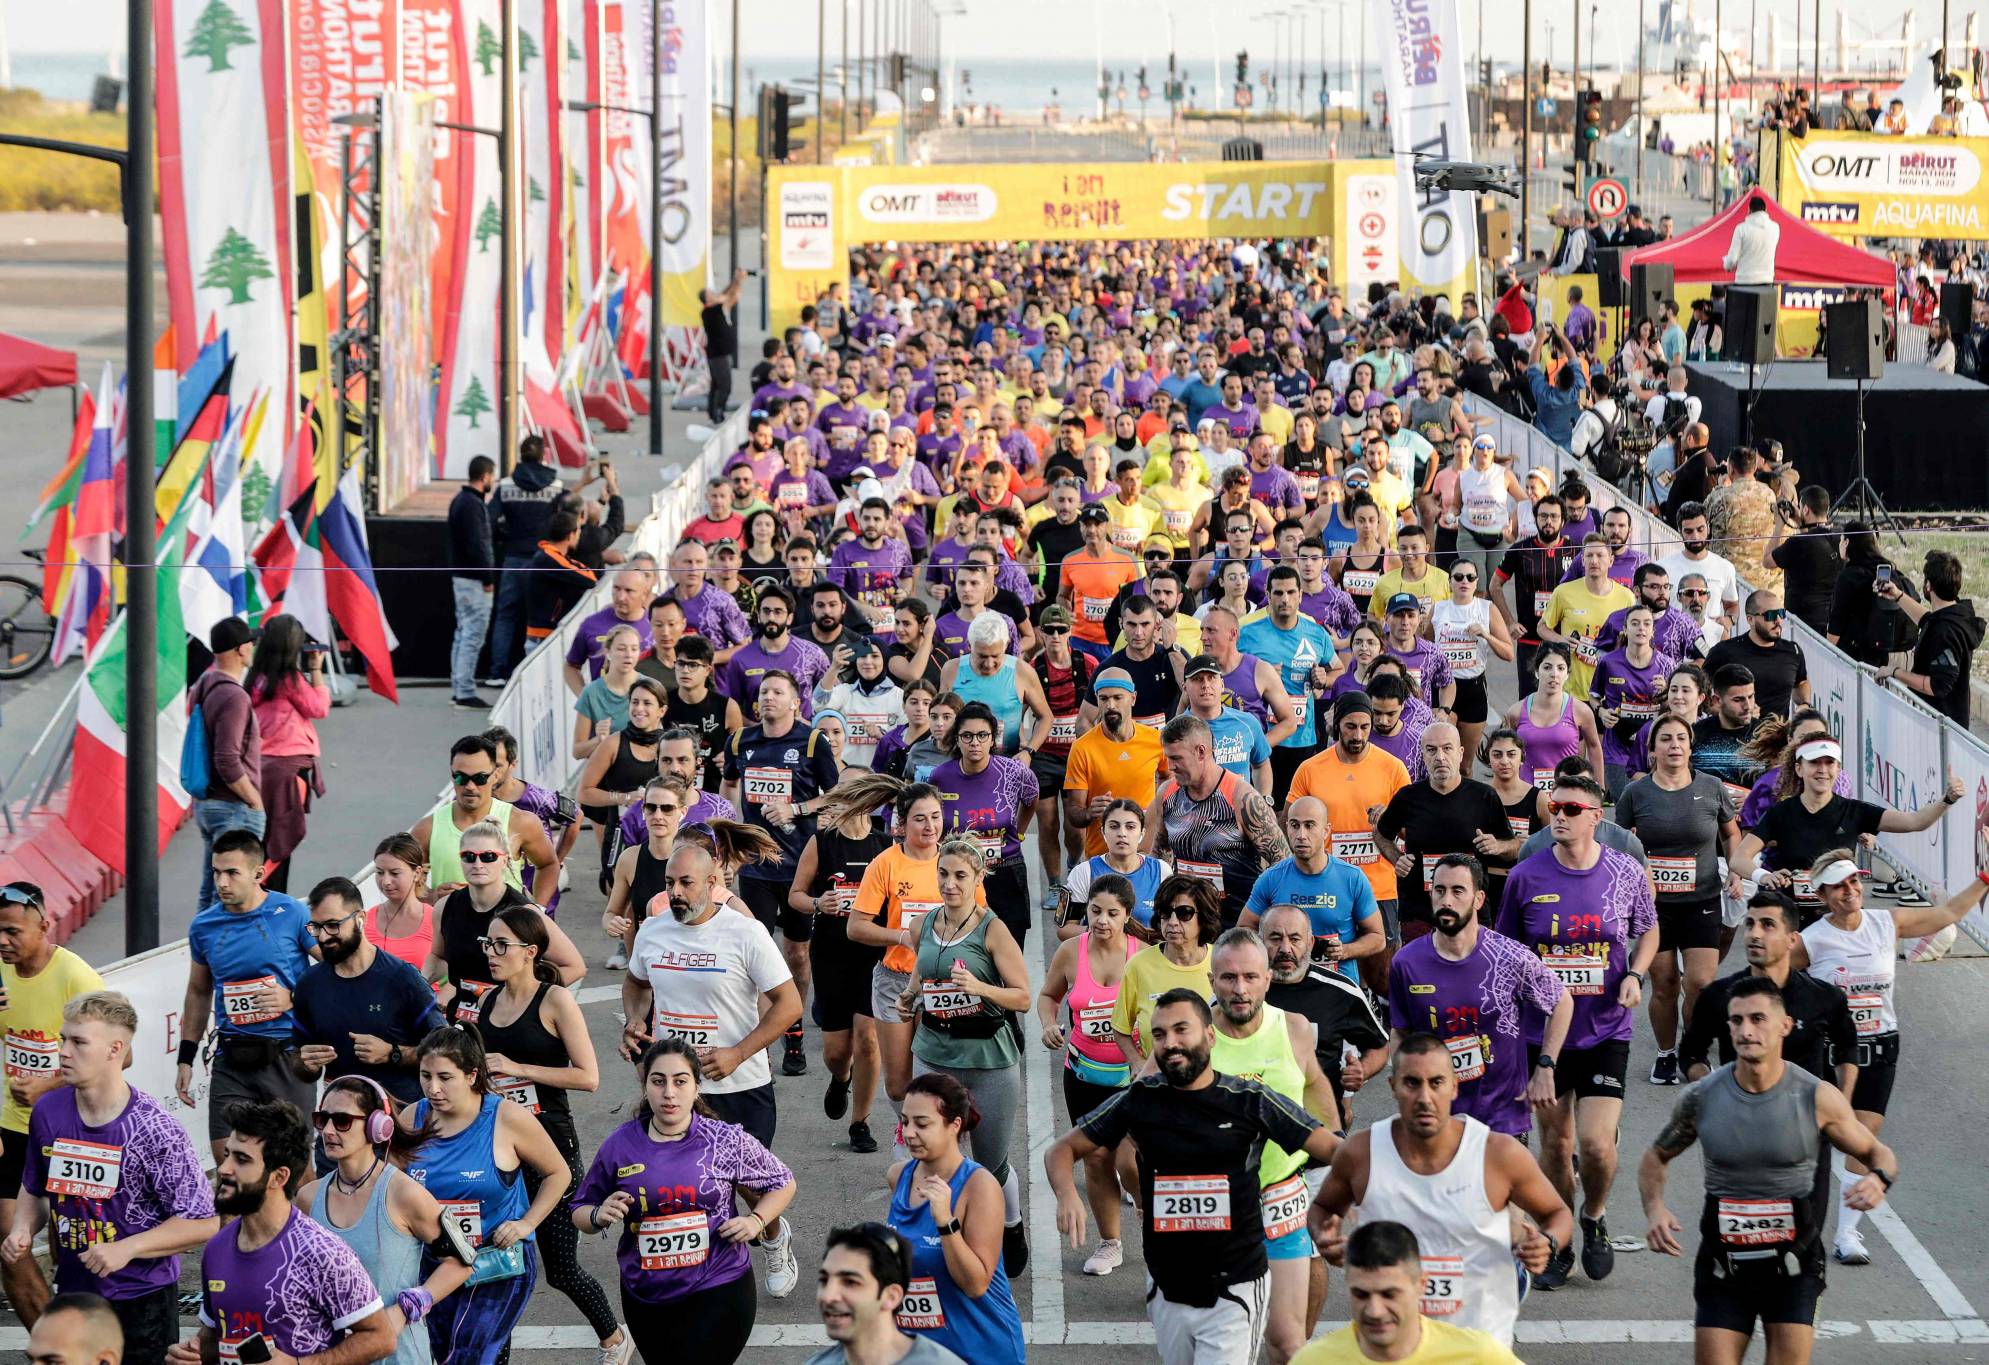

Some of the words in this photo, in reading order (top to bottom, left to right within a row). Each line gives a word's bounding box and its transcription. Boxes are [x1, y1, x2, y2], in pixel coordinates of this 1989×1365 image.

[1812, 154, 1881, 179] OMT
[1900, 152, 1957, 169] BEIRUT
[869, 195, 921, 213] OMT
[1162, 182, 1326, 221] START
[1803, 203, 1858, 222] mtv
[1874, 201, 1982, 230] AQUAFINA
[750, 780, 785, 794] 2702
[1340, 843, 1374, 856] 2771
[1652, 870, 1690, 882] 3026
[1290, 893, 1337, 909] Reezig
[660, 951, 717, 968] HILFIGER
[932, 993, 972, 1008] 2941
[667, 1028, 708, 1045] 2712
[10, 1049, 51, 1069] 3092
[61, 1160, 105, 1182] 3110
[638, 1186, 648, 1213] i
[1165, 1196, 1217, 1215] 2819
[1268, 1194, 1307, 1222] 2679
[1727, 1217, 1785, 1232] 2482
[645, 1232, 701, 1254] 2979
